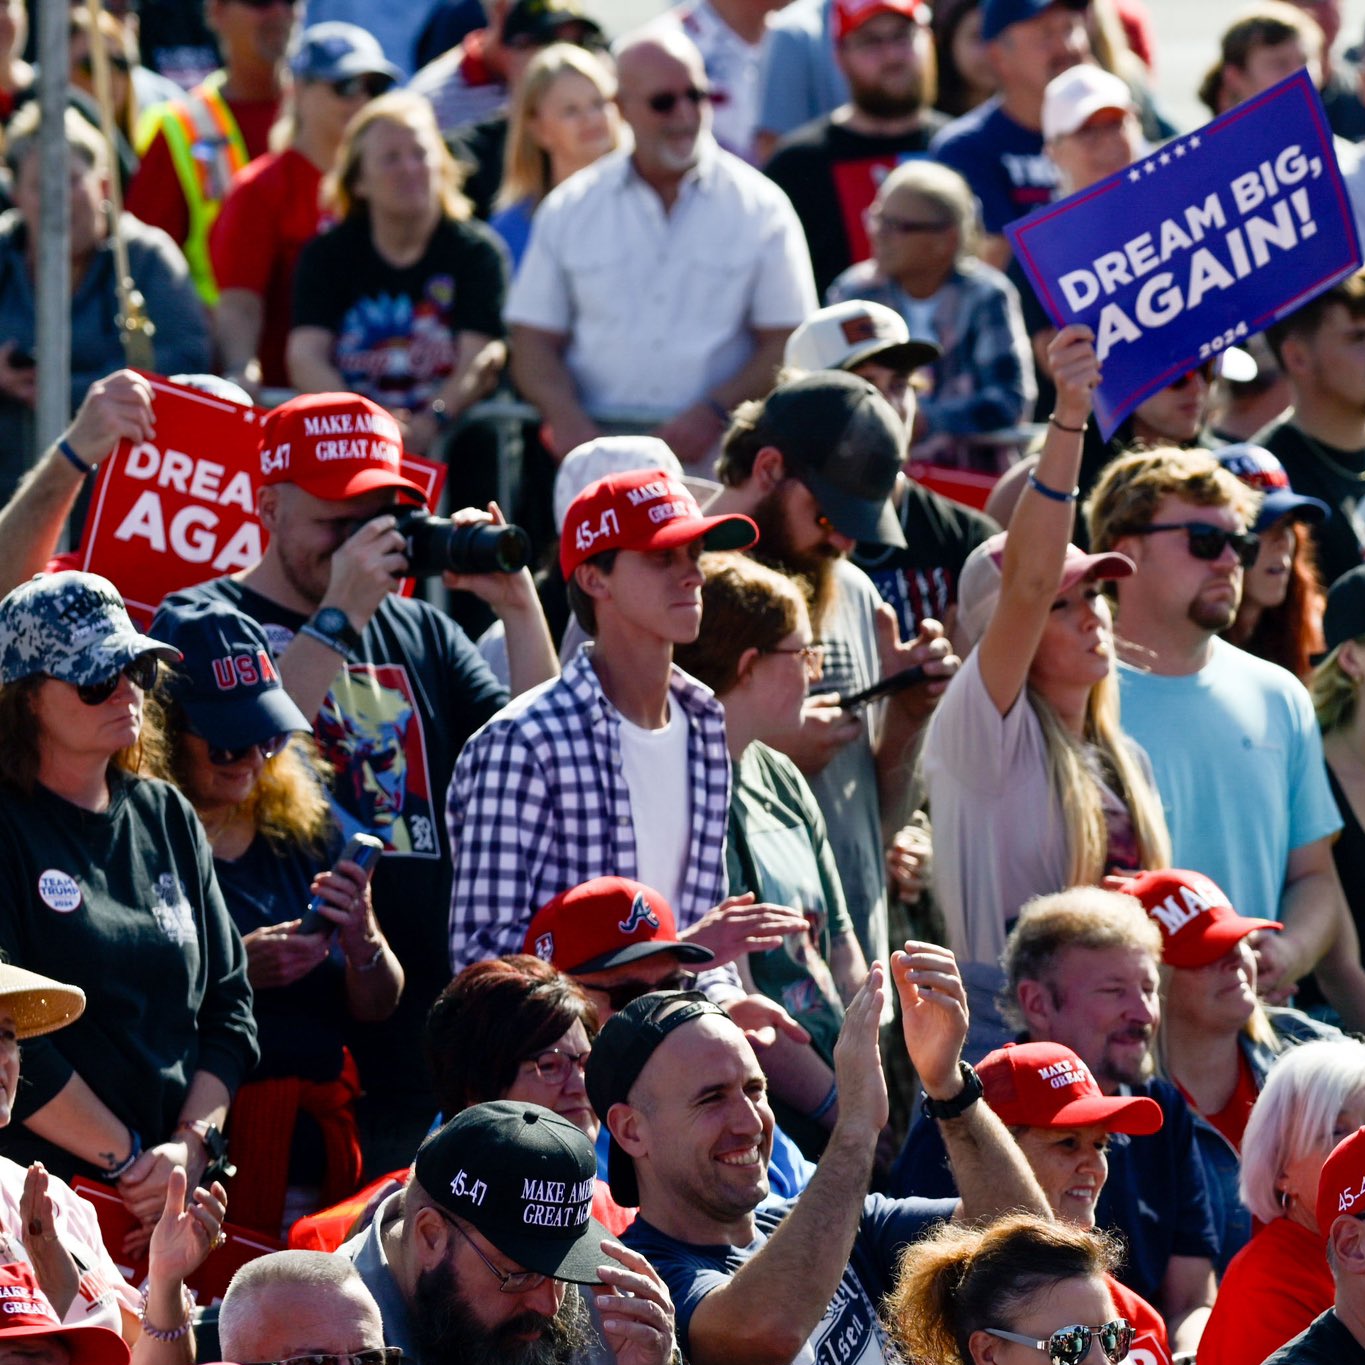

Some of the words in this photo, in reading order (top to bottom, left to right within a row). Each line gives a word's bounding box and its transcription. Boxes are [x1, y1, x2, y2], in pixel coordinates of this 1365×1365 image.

[1058, 196, 1223, 313] DREAM
[1229, 146, 1321, 222] BIG,
[1095, 188, 1319, 361] AGAIN!
[1199, 322, 1249, 359] 2024
[304, 417, 350, 438] MAKE
[316, 441, 368, 462] GREAT
[124, 440, 262, 517] DREA
[115, 510, 270, 576] AGA
[576, 508, 620, 552] 45-47
[211, 649, 281, 691] USA
[41, 885, 80, 897] TRUMP
[42, 878, 73, 891] TEAM
[1038, 1060, 1075, 1081] MAKE
[450, 1169, 489, 1207] 45-47
[520, 1178, 567, 1205] MAKE
[523, 1203, 573, 1227] GREAT
[0, 1286, 32, 1299] AKE
